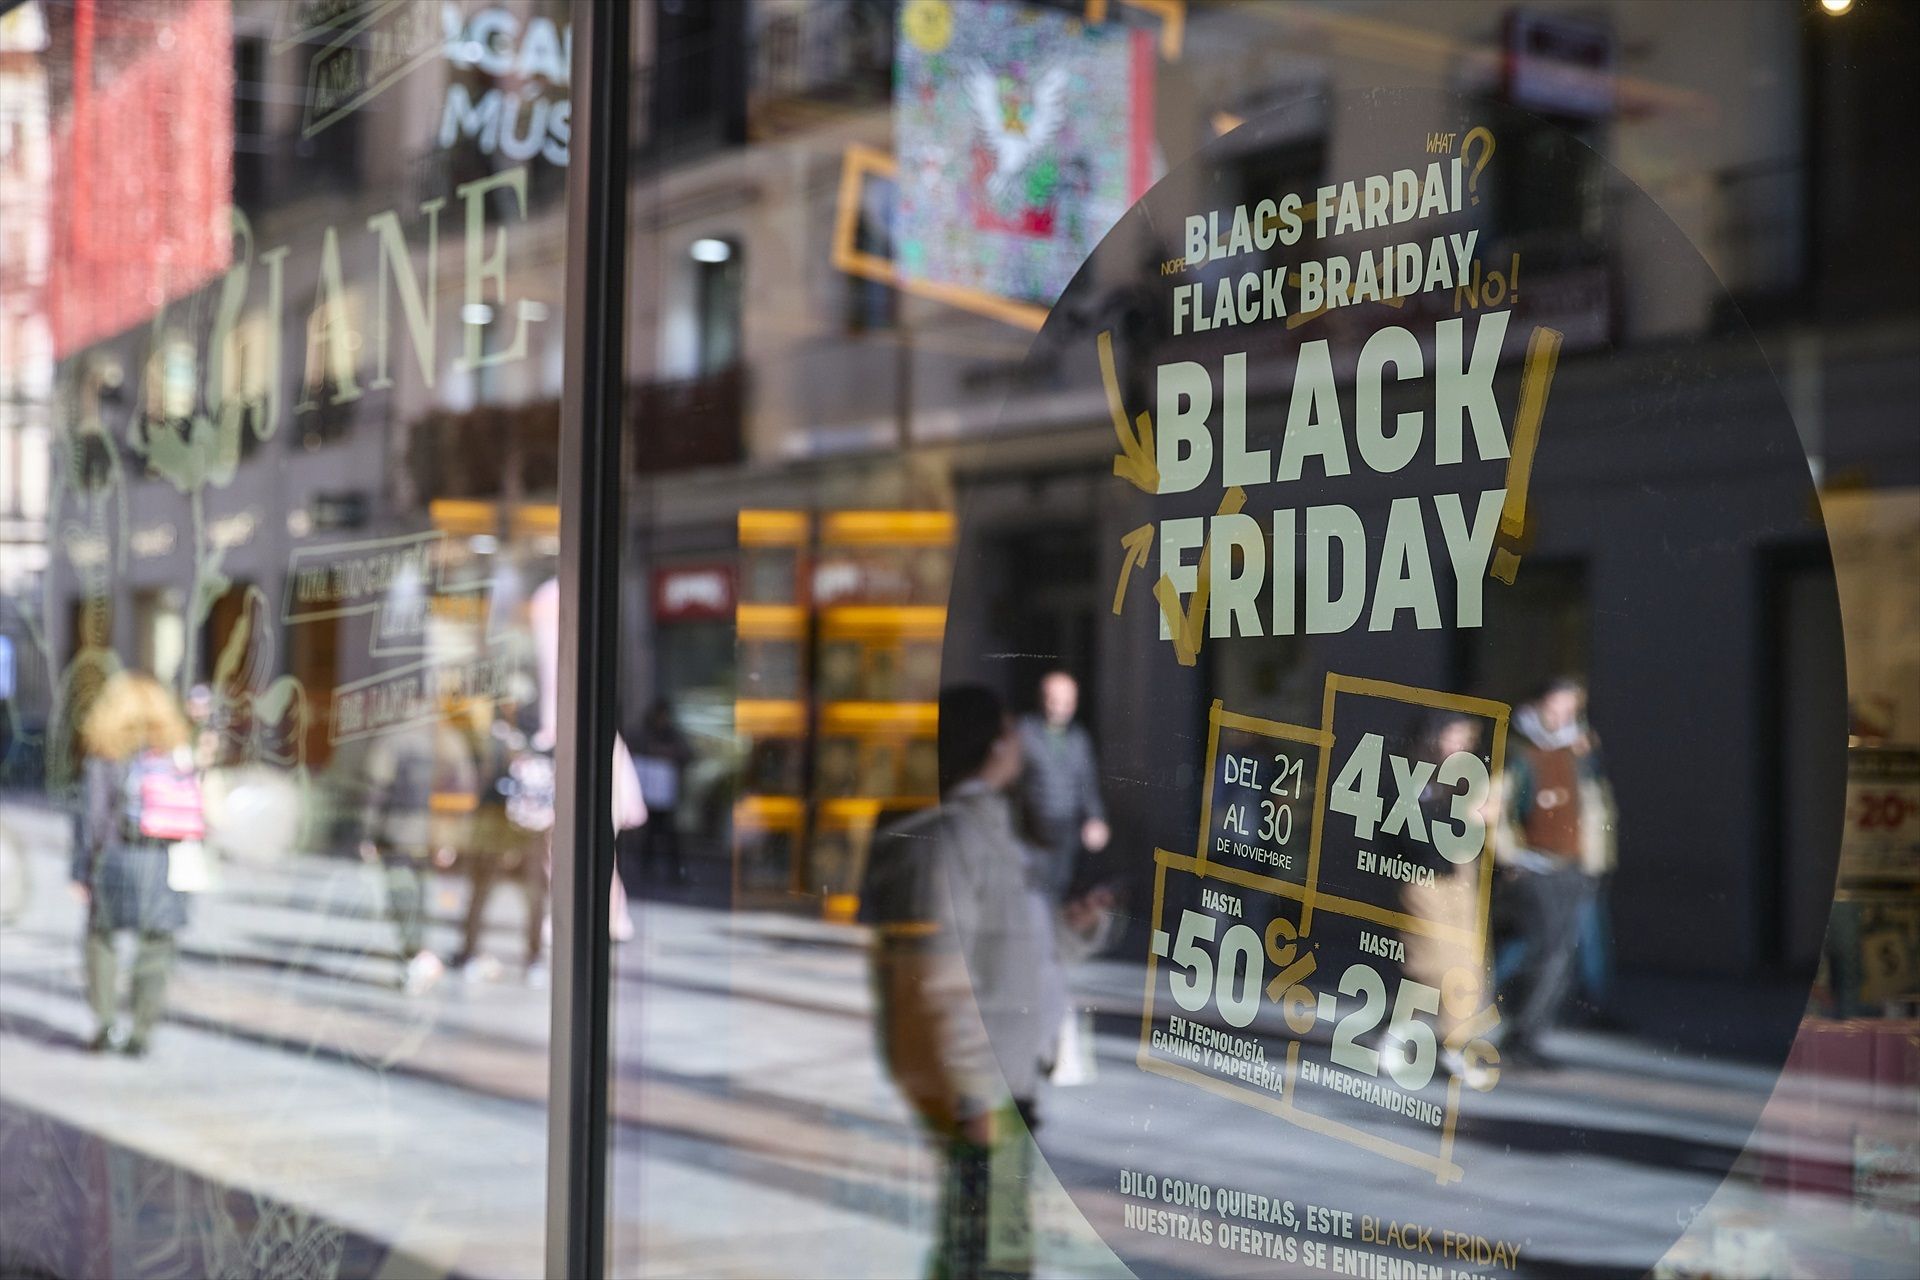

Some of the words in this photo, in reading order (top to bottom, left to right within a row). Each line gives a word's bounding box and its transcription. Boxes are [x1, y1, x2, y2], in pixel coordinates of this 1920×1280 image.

[1185, 193, 1302, 265] BLACS
[1317, 158, 1463, 239] FARDAI
[1161, 257, 1187, 276] NOPE
[1173, 266, 1287, 335] FLACK
[1301, 230, 1479, 313] BRAIDAY
[1157, 310, 1511, 494] BLACK
[1159, 489, 1508, 640] FRIDAY
[1224, 754, 1262, 790] DEL
[1270, 754, 1304, 799] 21
[1223, 803, 1249, 835] AL
[1258, 800, 1292, 845] 30
[1217, 837, 1231, 853] DE
[1233, 842, 1292, 870] NOVIEMBRE
[1356, 849, 1376, 873] EN
[1379, 853, 1436, 889] MÚSICA
[1201, 889, 1242, 918] HASTA
[1359, 931, 1405, 963] HASTA
[1152, 1030, 1200, 1063] GAMING
[1203, 1050, 1215, 1067] Y
[1214, 1054, 1283, 1094] PAPELERÍA
[1169, 1015, 1186, 1036] EN
[1189, 1021, 1268, 1070] TECNOLOGÍA,
[1301, 1059, 1319, 1084] EN
[1322, 1070, 1442, 1127] MERCHANDISING
[1120, 1170, 1157, 1200] DILO
[1162, 1178, 1211, 1211] COMO
[1216, 1188, 1301, 1233] QUIERAS,
[1306, 1205, 1353, 1239] ESTE
[1361, 1214, 1433, 1255] BLACK
[1443, 1229, 1521, 1271] FRIDAY
[1124, 1204, 1213, 1245] NUESTRAS
[1218, 1223, 1297, 1263] OFERTAS
[1303, 1241, 1327, 1269] SE
